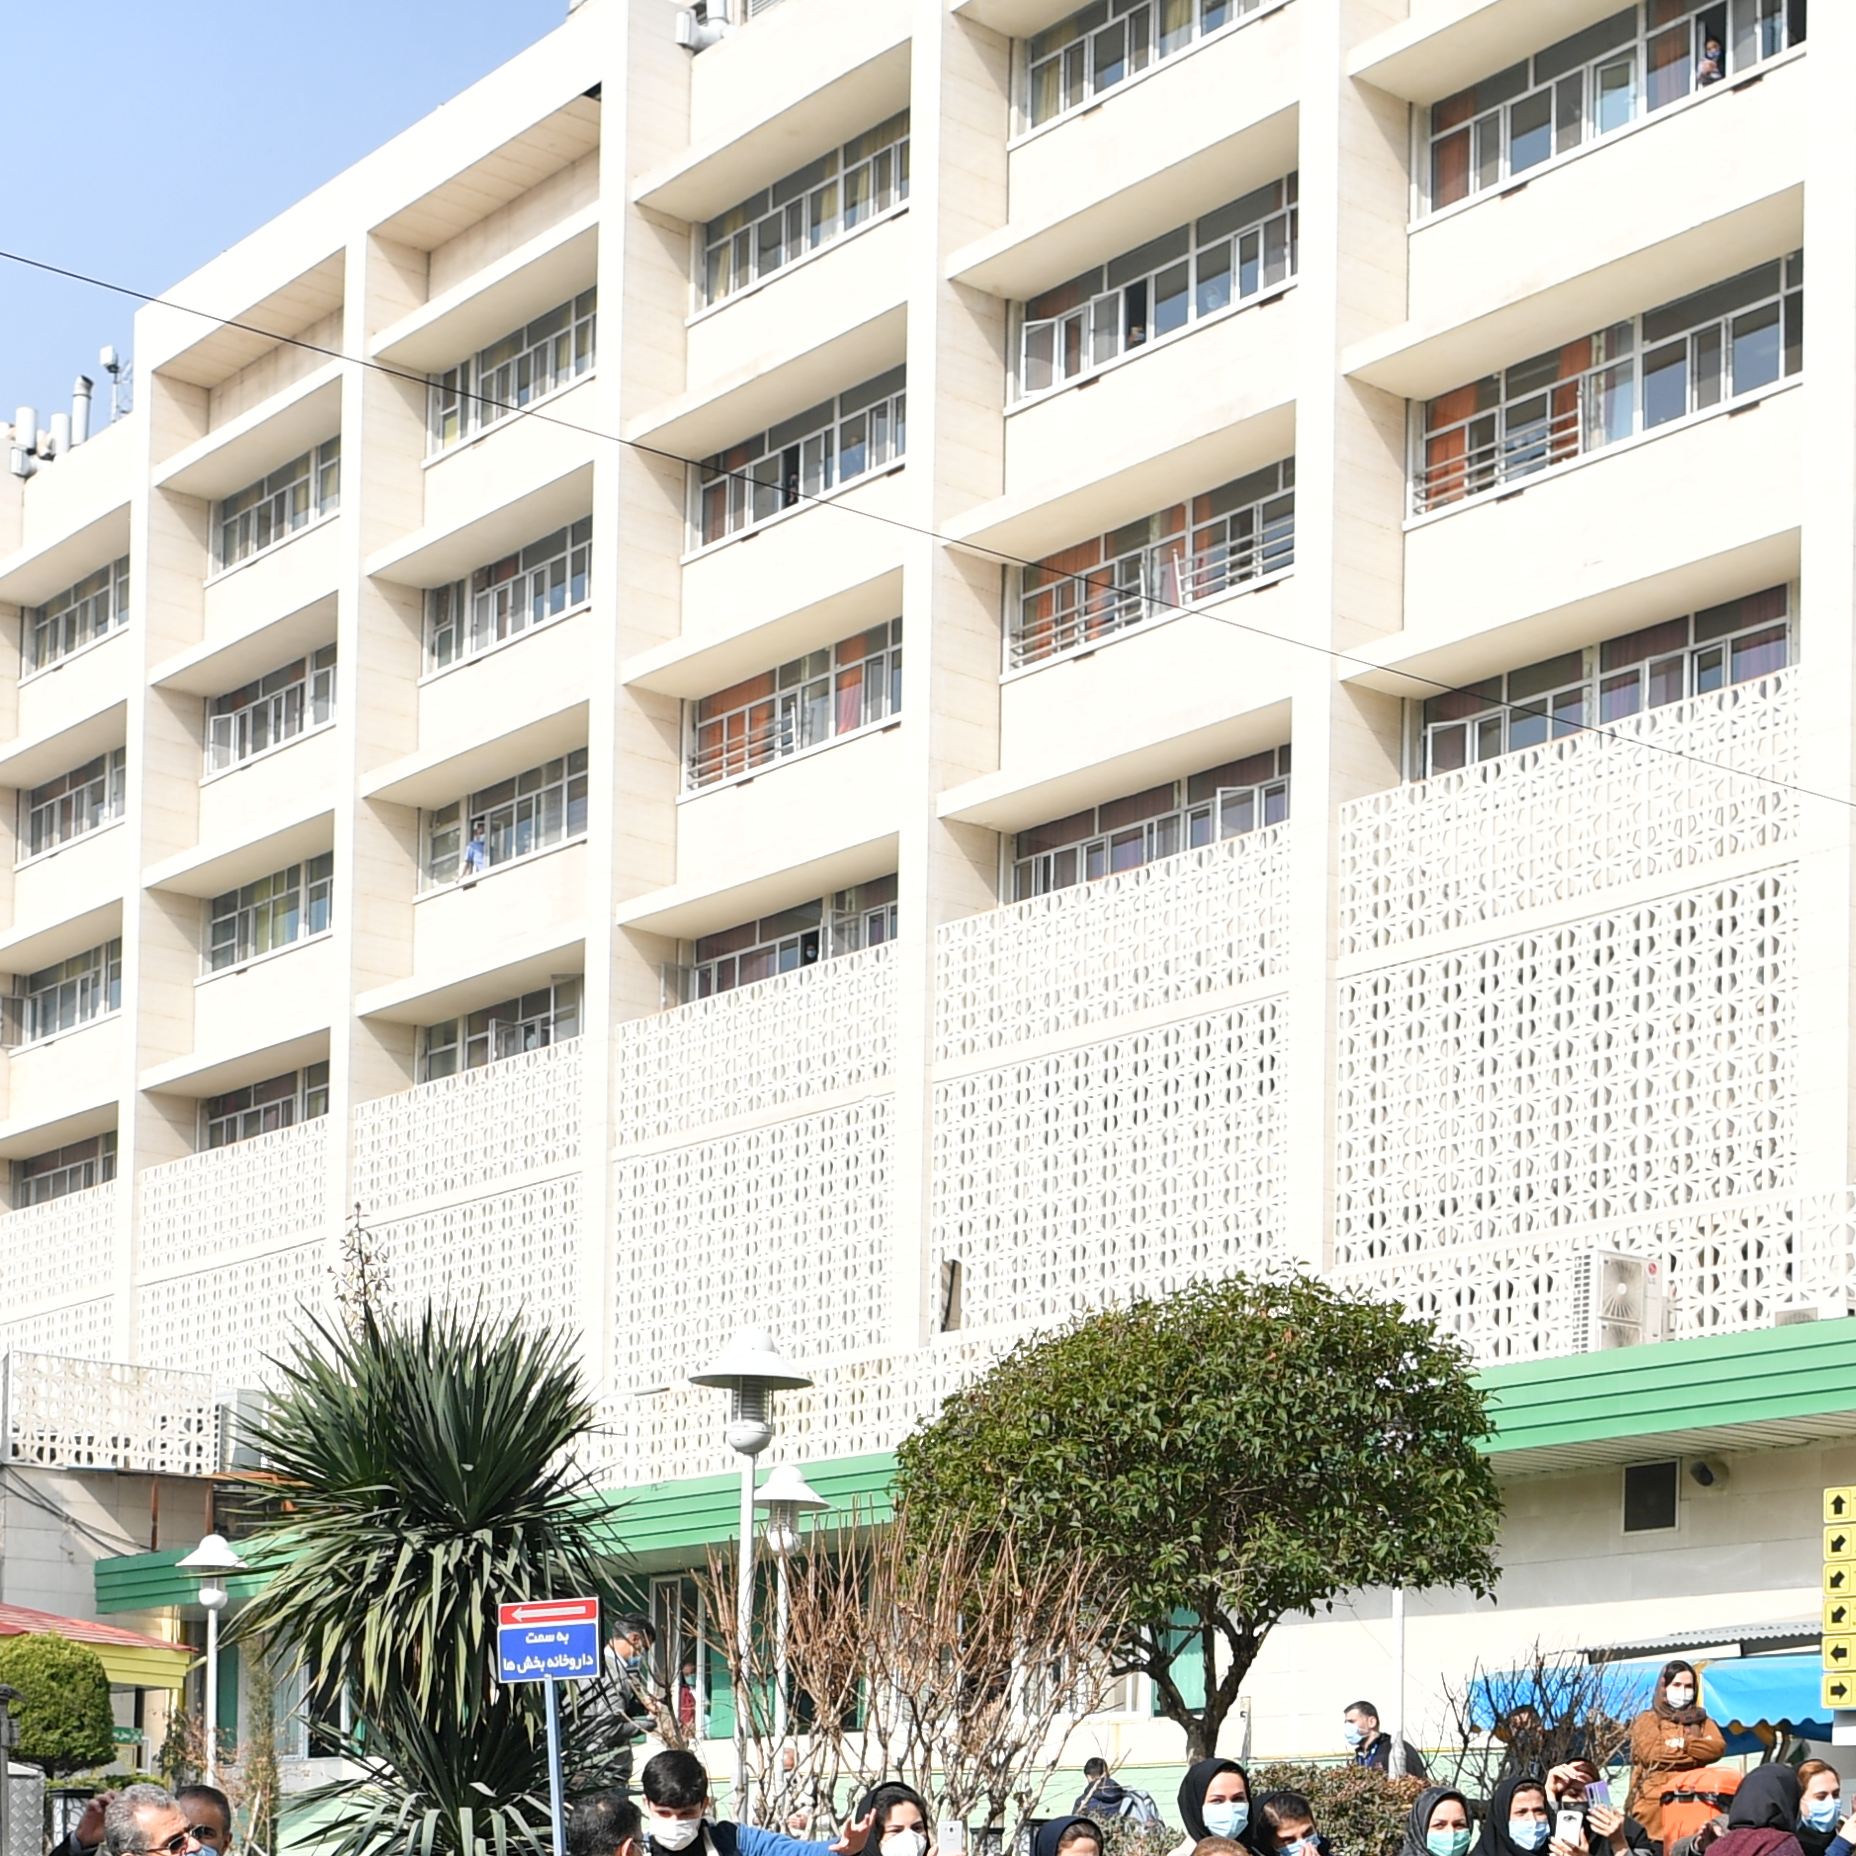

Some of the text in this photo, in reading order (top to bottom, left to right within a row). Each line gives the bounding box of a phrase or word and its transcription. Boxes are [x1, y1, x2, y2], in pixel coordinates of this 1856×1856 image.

[525, 1631, 569, 1645] به سمت
[503, 1653, 594, 1674] داروخانه بخش ها
